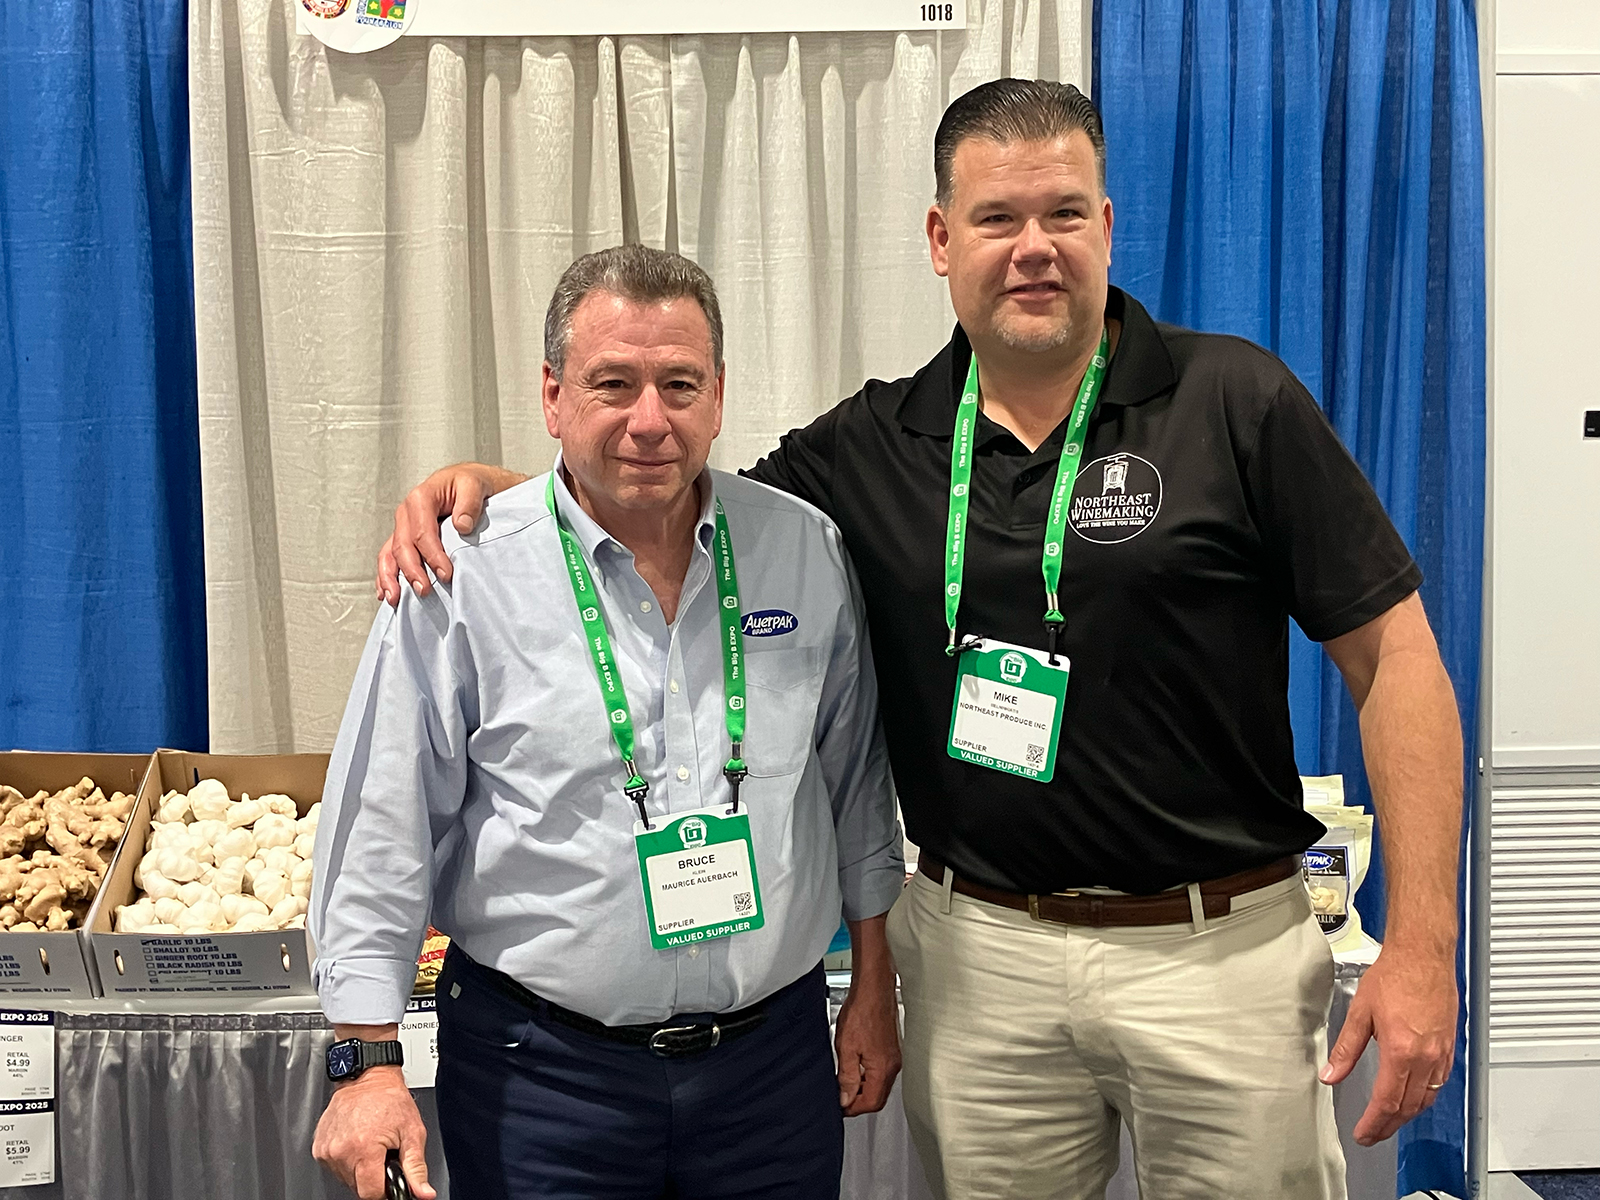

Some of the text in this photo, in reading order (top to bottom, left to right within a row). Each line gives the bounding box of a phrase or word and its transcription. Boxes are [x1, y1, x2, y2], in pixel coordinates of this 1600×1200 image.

[920, 4, 952, 21] 1018
[1086, 381, 1095, 392] The
[1075, 411, 1085, 427] EXPO
[1075, 493, 1151, 510] NORTHEAST
[1053, 504, 1061, 524] EXPO
[1071, 505, 1154, 520] WINEMAKING
[576, 572, 585, 591] EXPO
[742, 614, 793, 632] AuerPAK
[604, 672, 614, 692] EXPO
[994, 692, 1018, 705] MIKE
[960, 702, 999, 718] NORTHEAST
[1000, 713, 1033, 727] PRODUCE
[1034, 722, 1047, 731] INC.
[954, 738, 987, 752] SUPPLIER
[961, 751, 1038, 777] VALUED SUPPLIER
[678, 854, 716, 869] BRUCE
[662, 871, 738, 891] MAURICE AUERBACH
[658, 918, 694, 932] SUPPLIER
[1316, 914, 1336, 923] ARLIC
[666, 922, 750, 946] VALUED SUPPLIER
[0, 1013, 49, 1022] EXPO 2025
[6, 1146, 30, 1155] $5.99
